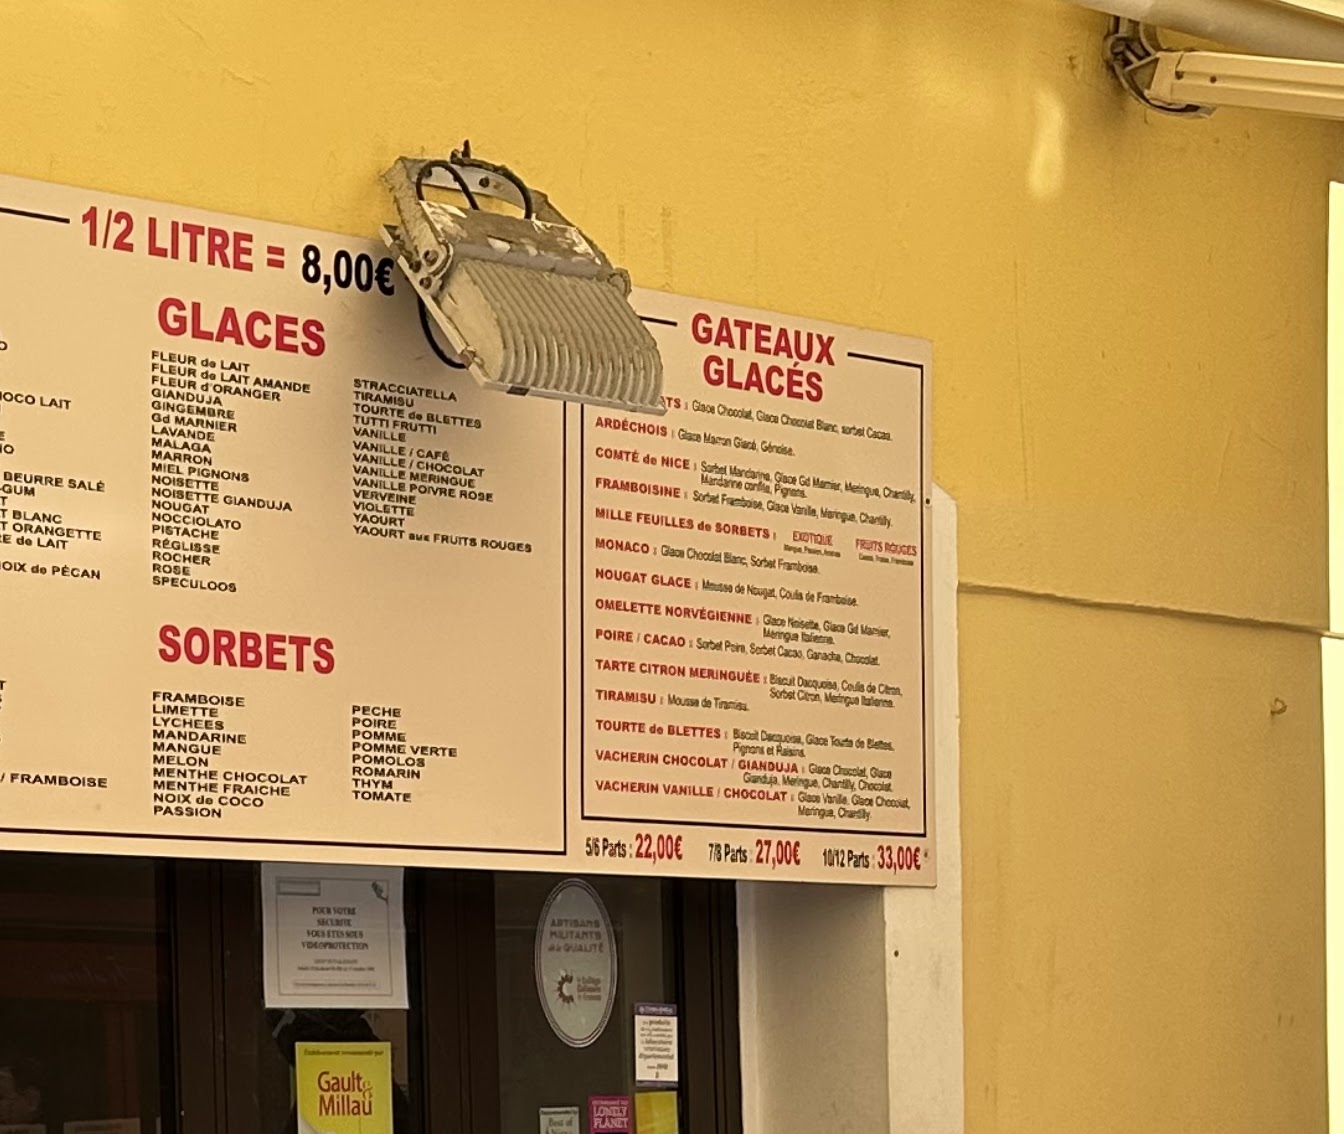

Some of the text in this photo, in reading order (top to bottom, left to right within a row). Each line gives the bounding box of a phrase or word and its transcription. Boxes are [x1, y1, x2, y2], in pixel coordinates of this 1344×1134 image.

[82, 206, 395, 295] 1/2 LITRE = 8,00€
[158, 298, 326, 357] GLACES
[691, 312, 835, 366] GATEAUX
[703, 355, 824, 402] GLACÉS
[40, 396, 72, 410] LAIT
[353, 415, 437, 434] TUTTI FRUTTI
[595, 416, 667, 437] ARDÉCHOIS
[353, 427, 406, 442] VANILLE
[152, 450, 212, 466] MARRON
[595, 447, 690, 470] COMTÉ de NICE
[152, 476, 219, 491] NOISETTE
[595, 477, 680, 498] FRAMBOISINE
[152, 500, 210, 514] NOUGAT
[353, 502, 415, 516] VIOLETTE
[353, 513, 405, 527] YAOURT
[595, 507, 770, 540] MILLE FEUILLES de SORBETS
[152, 525, 219, 540] PISTACHE
[595, 537, 649, 554] MONACO
[152, 551, 211, 566] ROCHER
[152, 563, 191, 576] ROSE
[596, 568, 647, 583] NOUGAT
[152, 576, 237, 592] SPECULOOS
[596, 599, 752, 625] OMELETTE NORVÉGIENNE
[596, 629, 634, 642] POIRE
[644, 634, 686, 647] CACAO
[158, 624, 335, 675] SORBETS
[596, 659, 760, 683] TARTE CITRON MERINGUÉE
[153, 691, 245, 707] FRAMBOISE
[596, 690, 656, 704] TIRAMISU
[352, 705, 402, 718] PECHE
[352, 718, 397, 729] POIRE
[596, 720, 721, 739] TOURTE de BLETTES
[352, 730, 406, 742] POMME
[153, 742, 222, 756] MANGUE
[153, 755, 209, 767] MELON
[596, 750, 659, 764] VACHERIN
[663, 754, 728, 769] CHOCOLAT
[738, 760, 798, 774] GIANDUJA
[0, 773, 5, 782] /
[11, 773, 108, 788] FRAMBOISE
[352, 779, 393, 790] THYM
[352, 790, 411, 802] TOMATE
[596, 780, 659, 794] VACHERIN
[663, 784, 714, 798] VANILLE
[724, 788, 788, 802] CHOCOLAT
[154, 805, 222, 818] PASSION
[585, 833, 683, 863] 5/6 Parts 22,00€
[709, 840, 801, 869] 7/8 Parts 27,00€
[823, 845, 921, 875] 10/12 Parts 33,00€
[312, 907, 356, 915] POUR VOTRE
[550, 919, 600, 928] ARTISANS
[307, 930, 326, 938] VOUS
[346, 930, 364, 938] SOUS
[550, 931, 601, 940] MILITANTS
[563, 942, 603, 953] QUALITÉ
[318, 1071, 362, 1092] Gault
[319, 1094, 372, 1116] Millau
[593, 1106, 627, 1117] LONELY
[593, 1117, 628, 1129] PLANET
